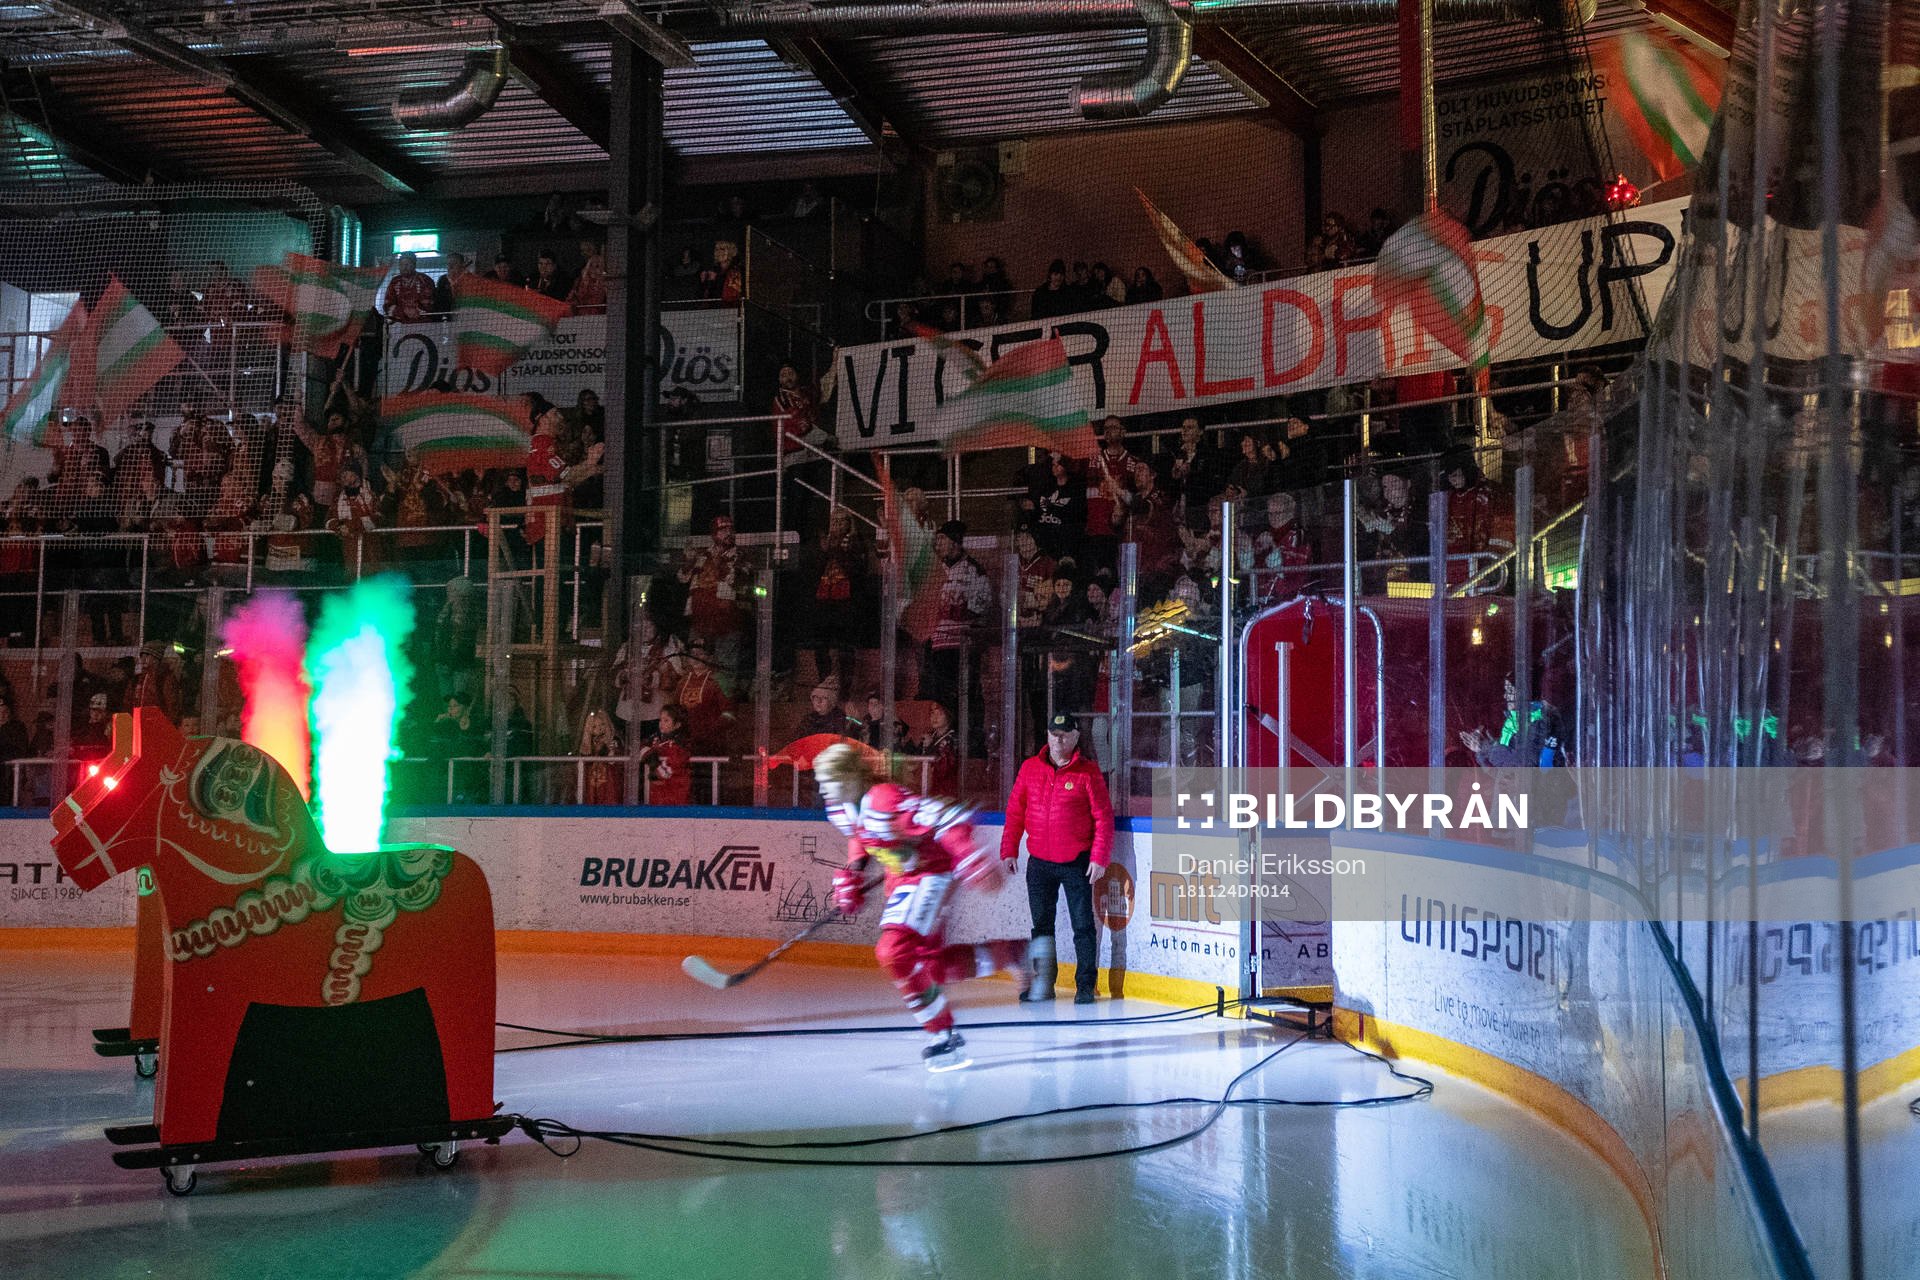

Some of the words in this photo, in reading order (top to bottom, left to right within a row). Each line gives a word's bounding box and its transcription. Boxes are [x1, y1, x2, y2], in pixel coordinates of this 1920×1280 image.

[1526, 209, 1688, 341] UP
[580, 846, 775, 892] BRUBAKKEN
[11, 887, 49, 900] SINCE
[54, 887, 84, 900] 1989
[579, 893, 691, 907] www.brubakken.se
